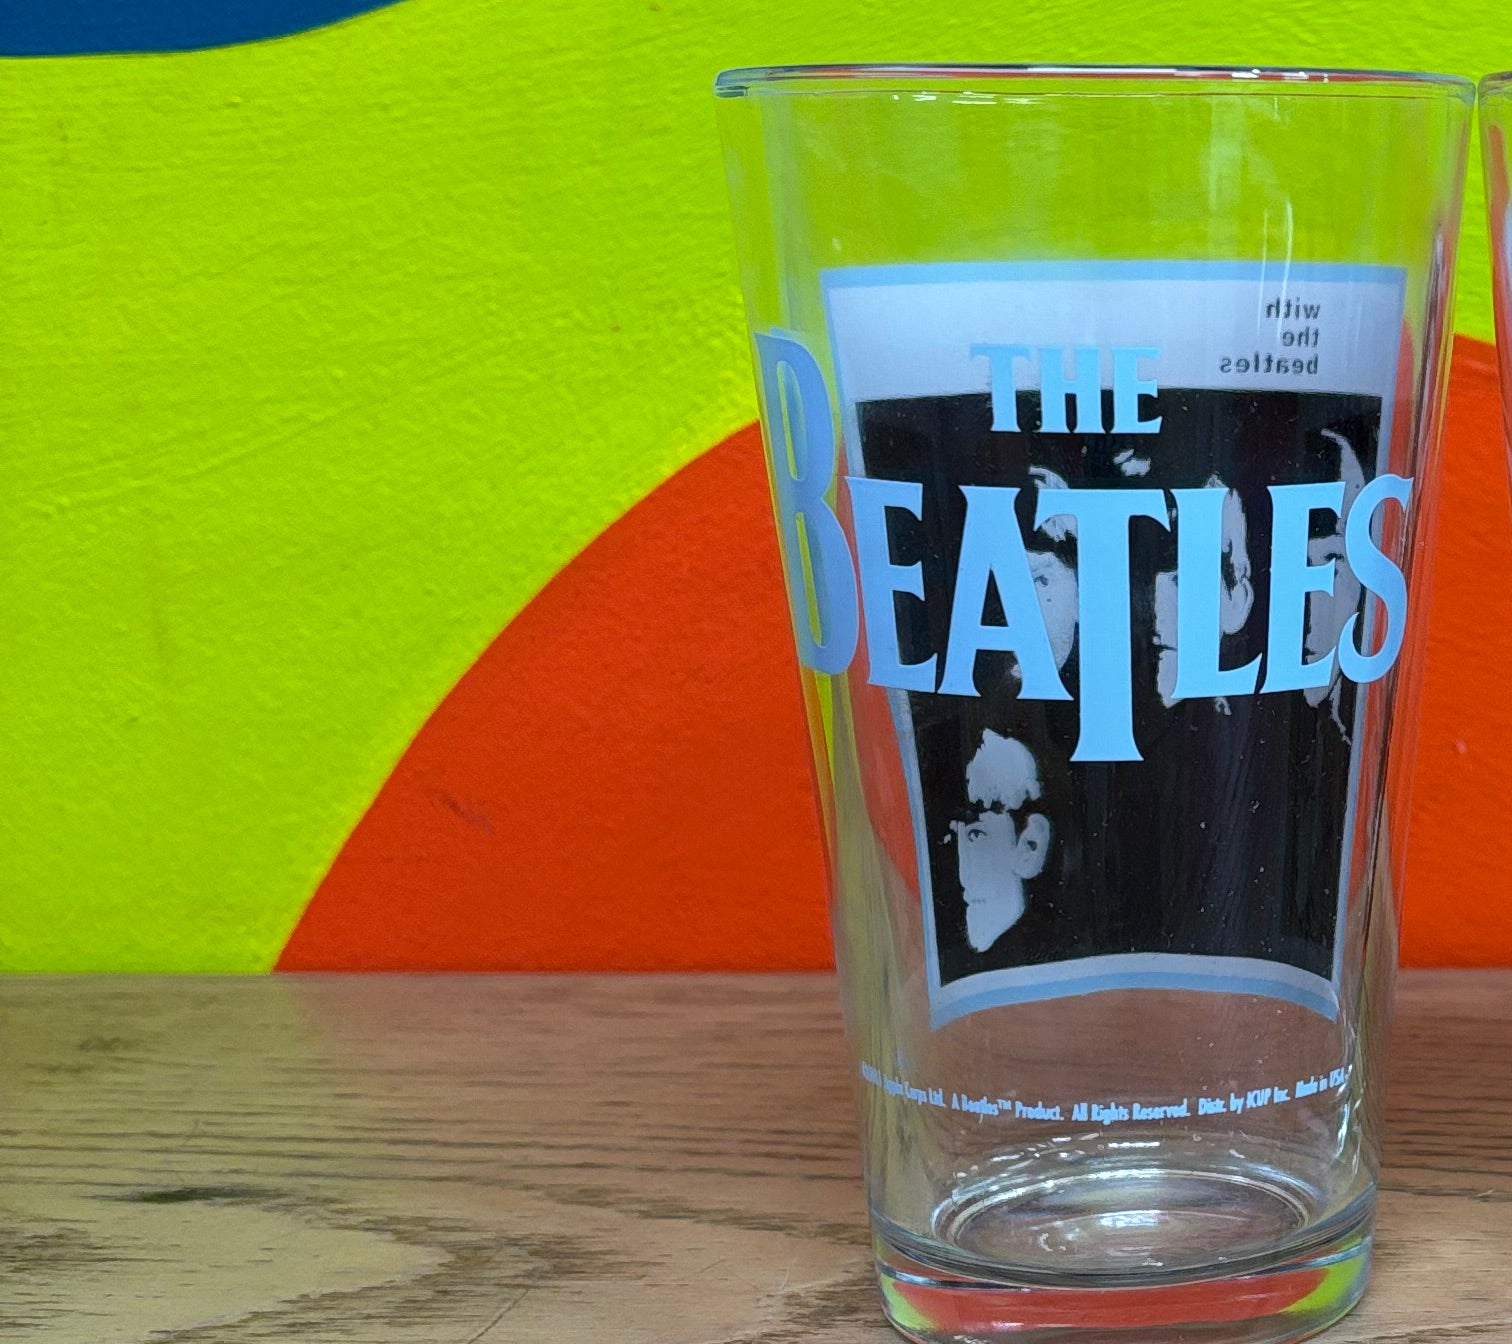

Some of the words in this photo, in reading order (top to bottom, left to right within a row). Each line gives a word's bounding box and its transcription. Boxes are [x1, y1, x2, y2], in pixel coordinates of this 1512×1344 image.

[970, 343, 1162, 434] THE
[755, 329, 1414, 762] BEATLES
[951, 1092, 960, 1110] A
[1015, 1101, 1064, 1121] Product.
[1072, 1103, 1088, 1121] All
[1091, 1102, 1129, 1125] Rights
[1132, 1099, 1190, 1121] Reserved.
[1230, 1093, 1244, 1114] by
